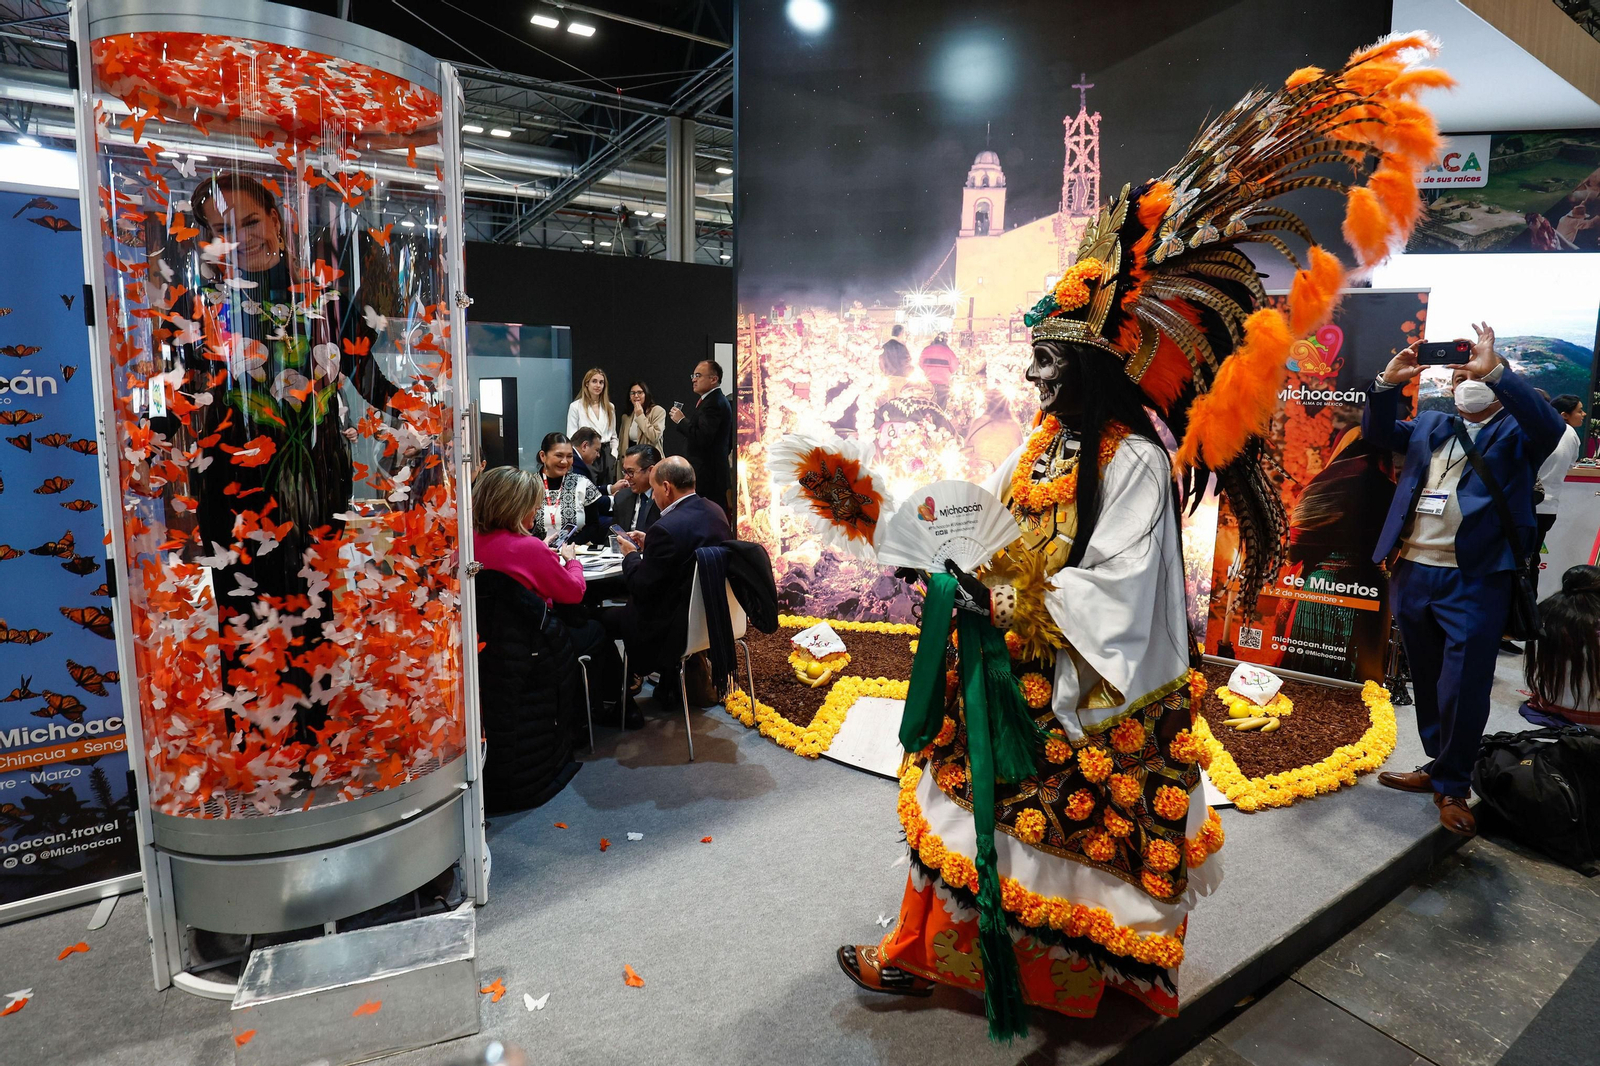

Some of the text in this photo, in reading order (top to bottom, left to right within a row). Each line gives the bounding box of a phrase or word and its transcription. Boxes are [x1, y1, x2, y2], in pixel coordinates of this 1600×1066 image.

[1277, 384, 1366, 403] Michoacán
[939, 502, 983, 517] Michoacán
[1283, 573, 1379, 598] de Muertos
[1268, 588, 1274, 596] y
[1281, 589, 1293, 597] de
[1294, 592, 1338, 604] noviembre
[1271, 635, 1347, 654] michoacan.travel
[1305, 649, 1346, 661] @Michoacan
[30, 767, 82, 785] Marzo
[40, 834, 122, 860] @Michoacan
